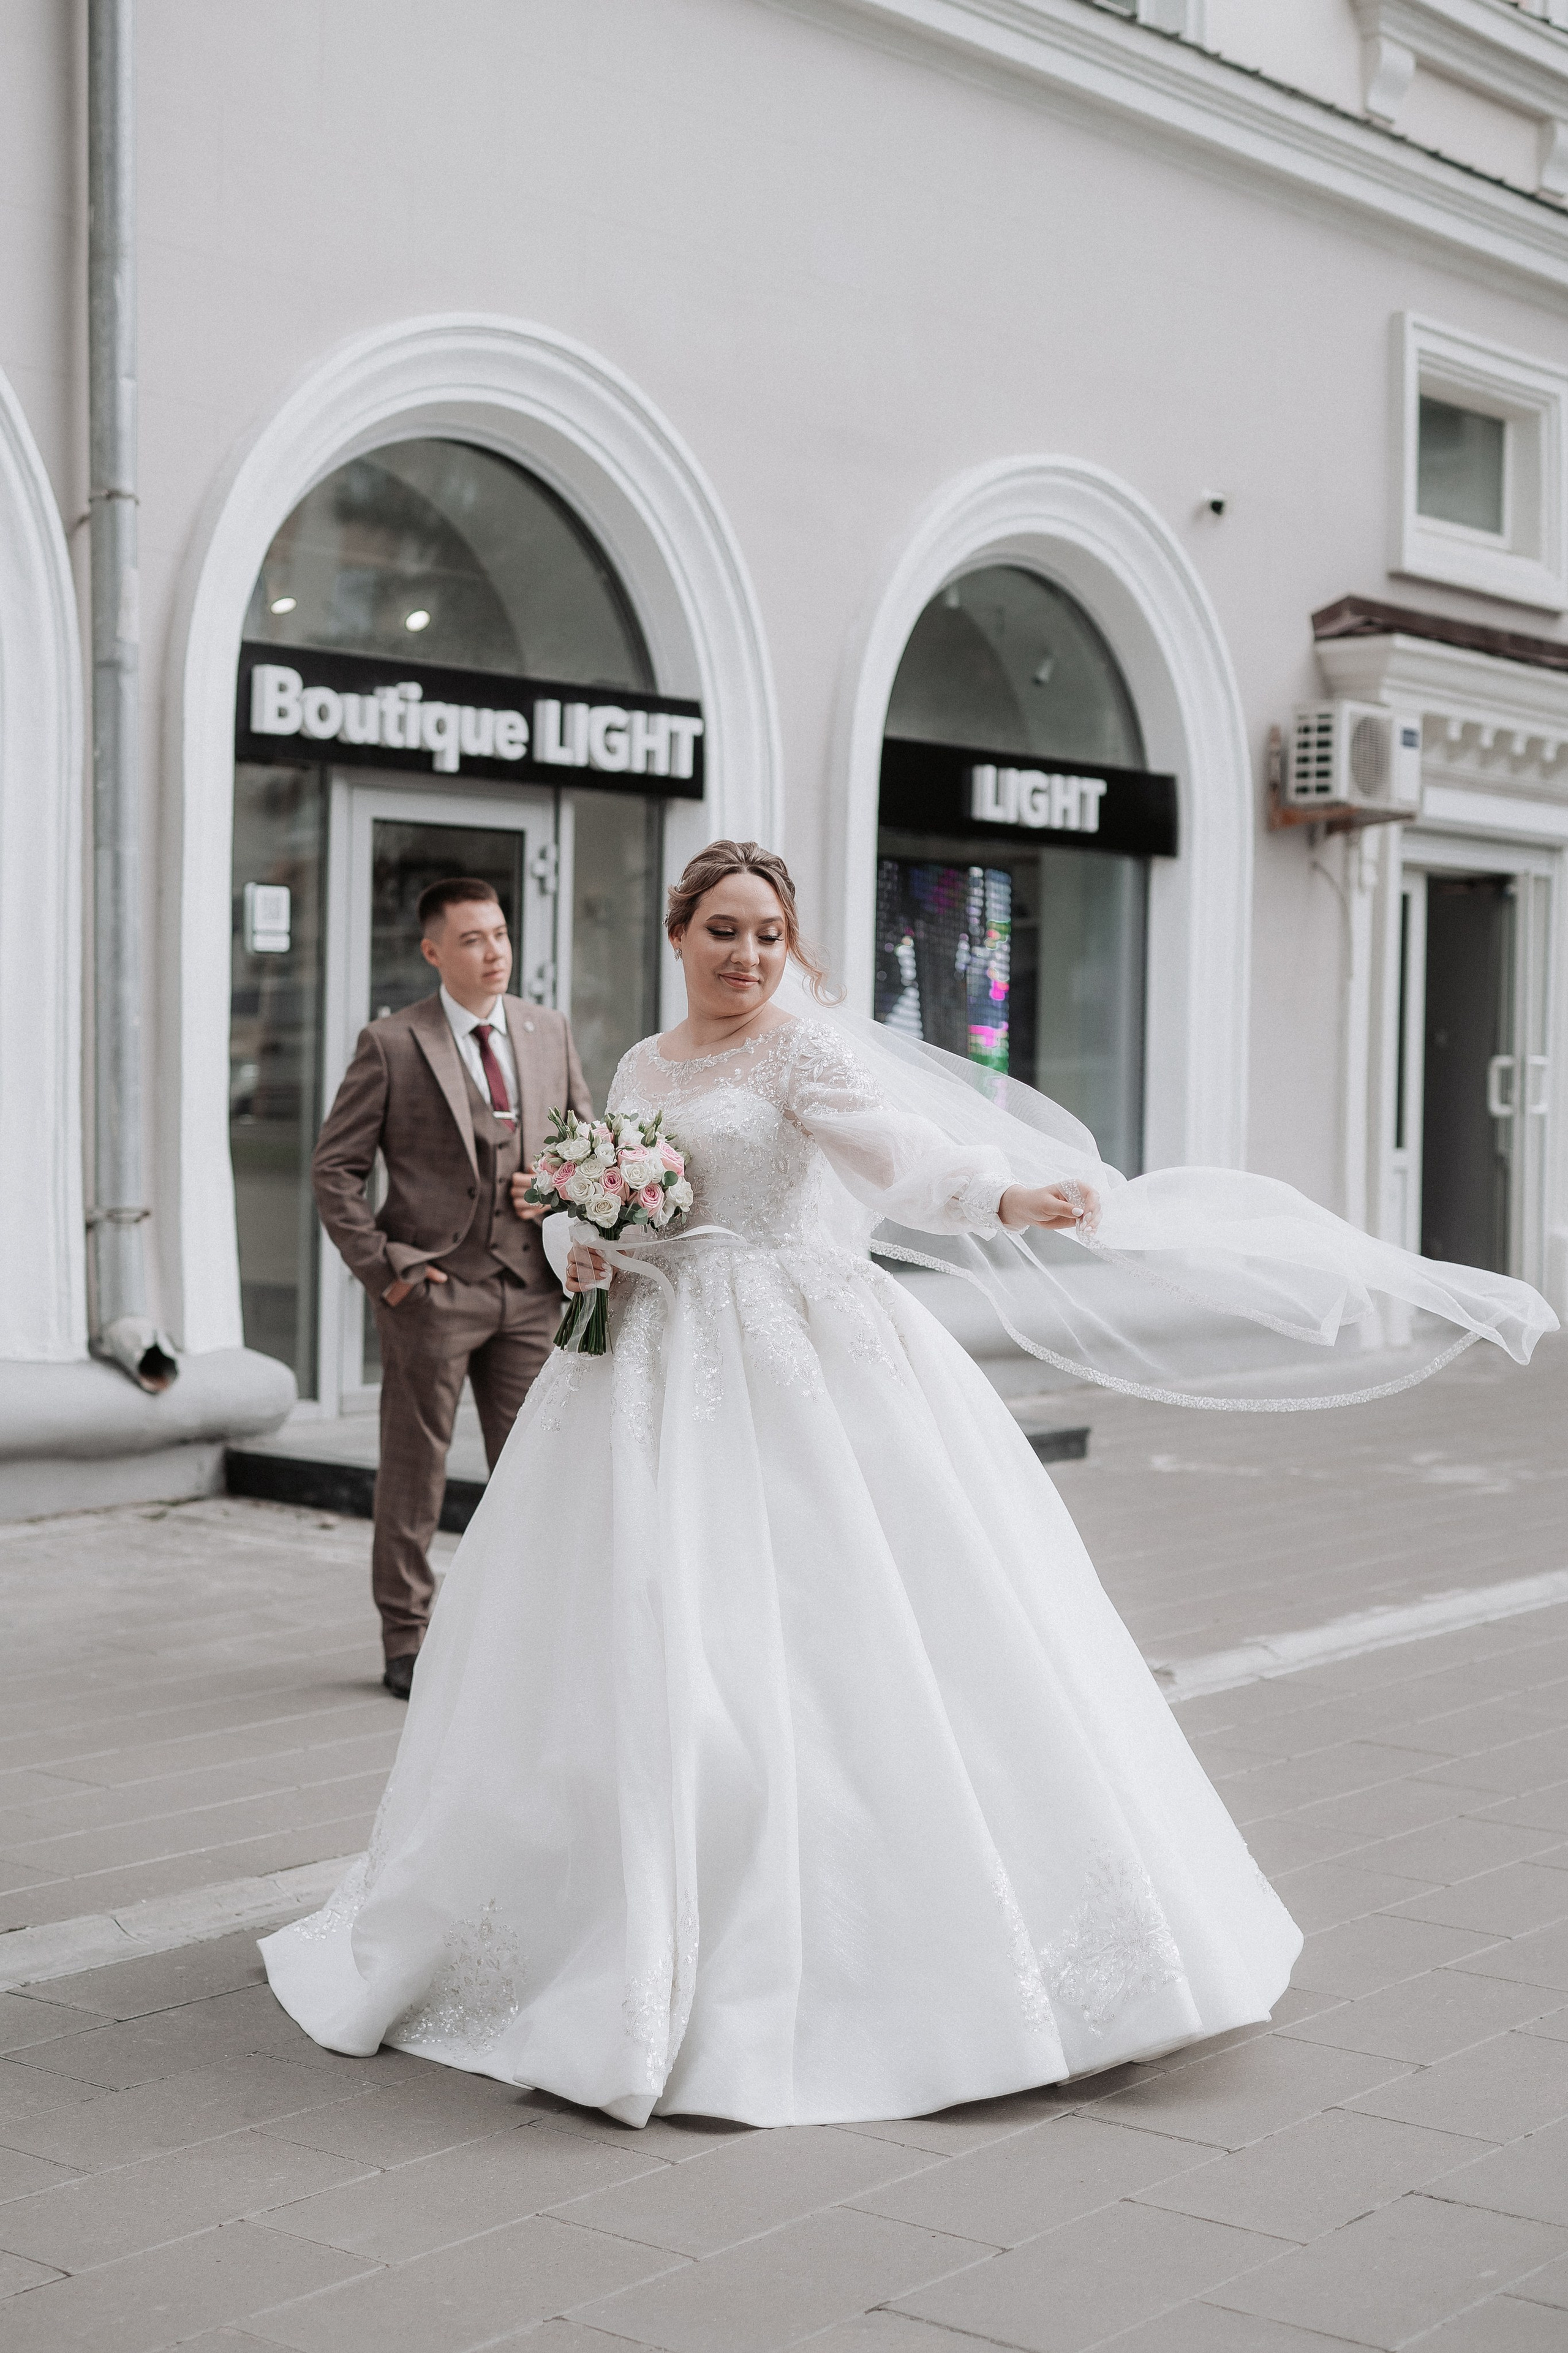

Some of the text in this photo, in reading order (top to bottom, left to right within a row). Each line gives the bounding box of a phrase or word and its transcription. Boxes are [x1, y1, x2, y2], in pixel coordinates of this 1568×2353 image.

[251, 663, 704, 779] Boutique LIGHT
[972, 764, 1107, 833] LIGHT
